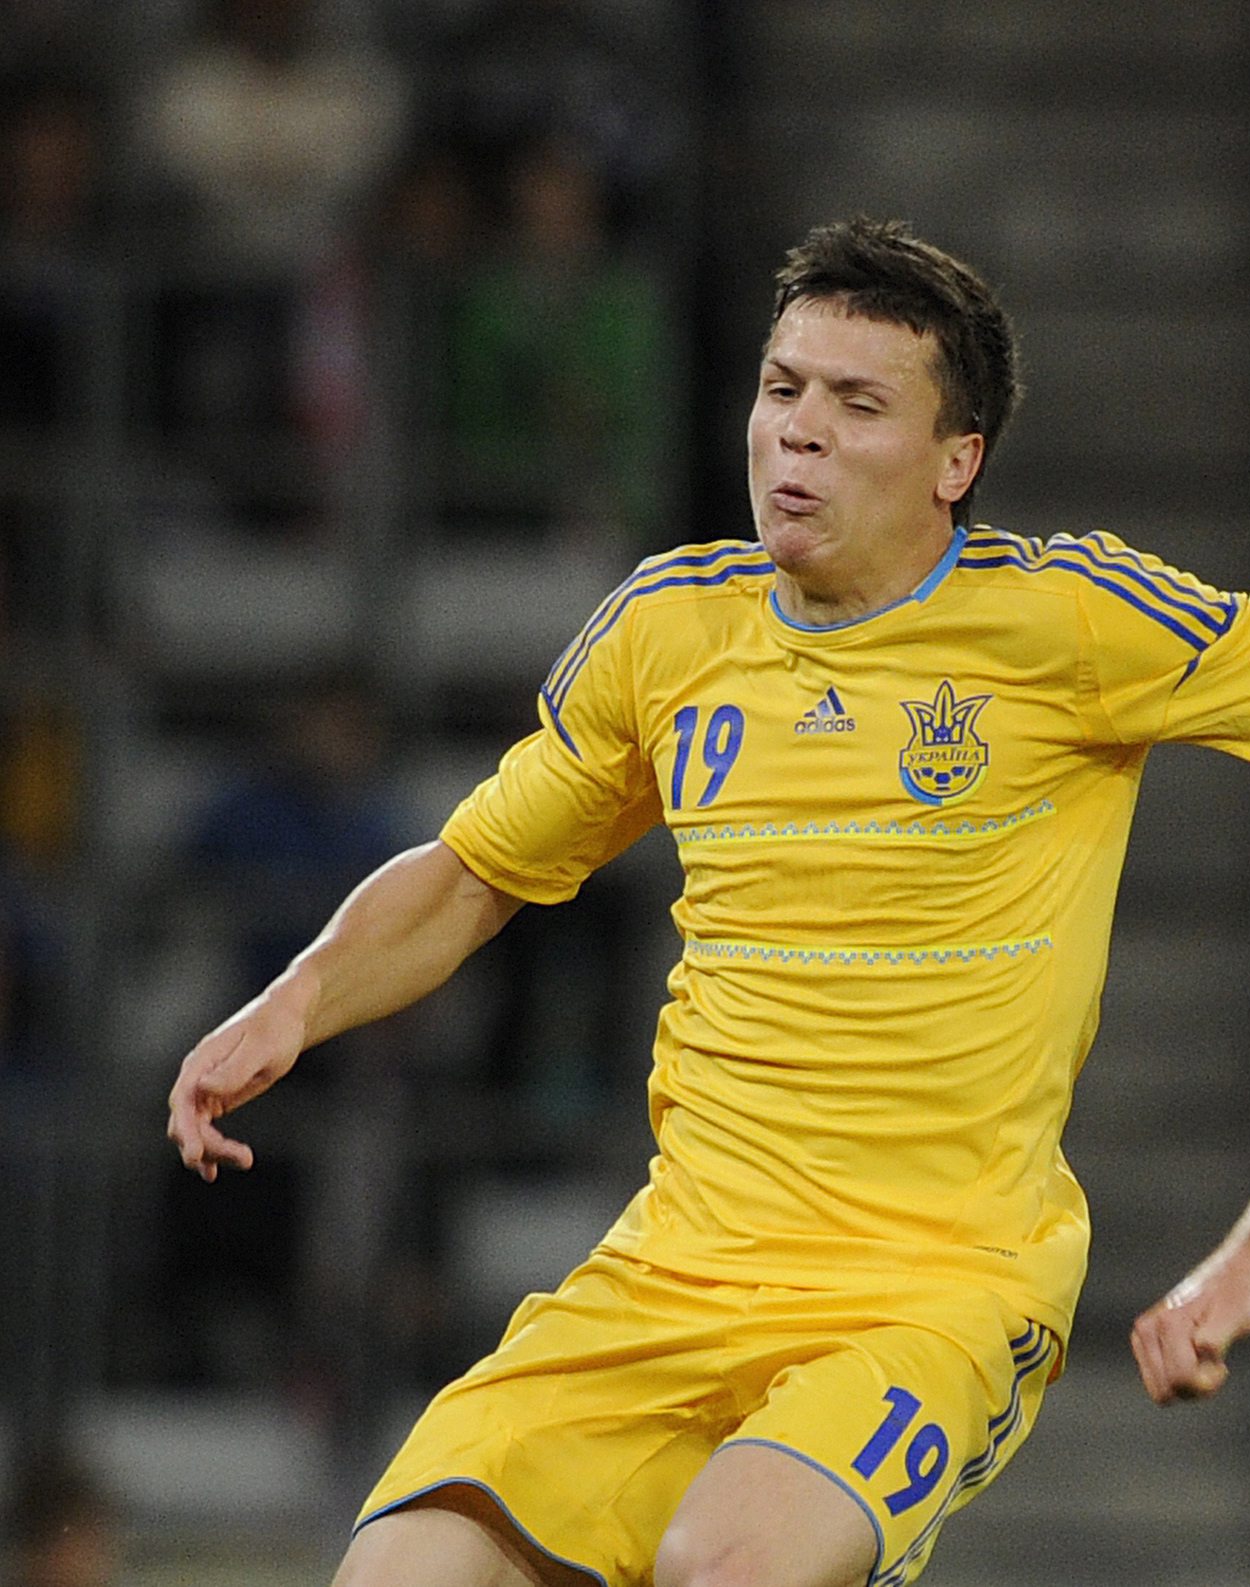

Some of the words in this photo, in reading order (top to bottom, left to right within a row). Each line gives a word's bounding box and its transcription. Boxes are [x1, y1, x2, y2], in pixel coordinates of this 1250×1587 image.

[672, 705, 744, 809] 19
[794, 717, 856, 735] adidas
[851, 1386, 949, 1516] 19
